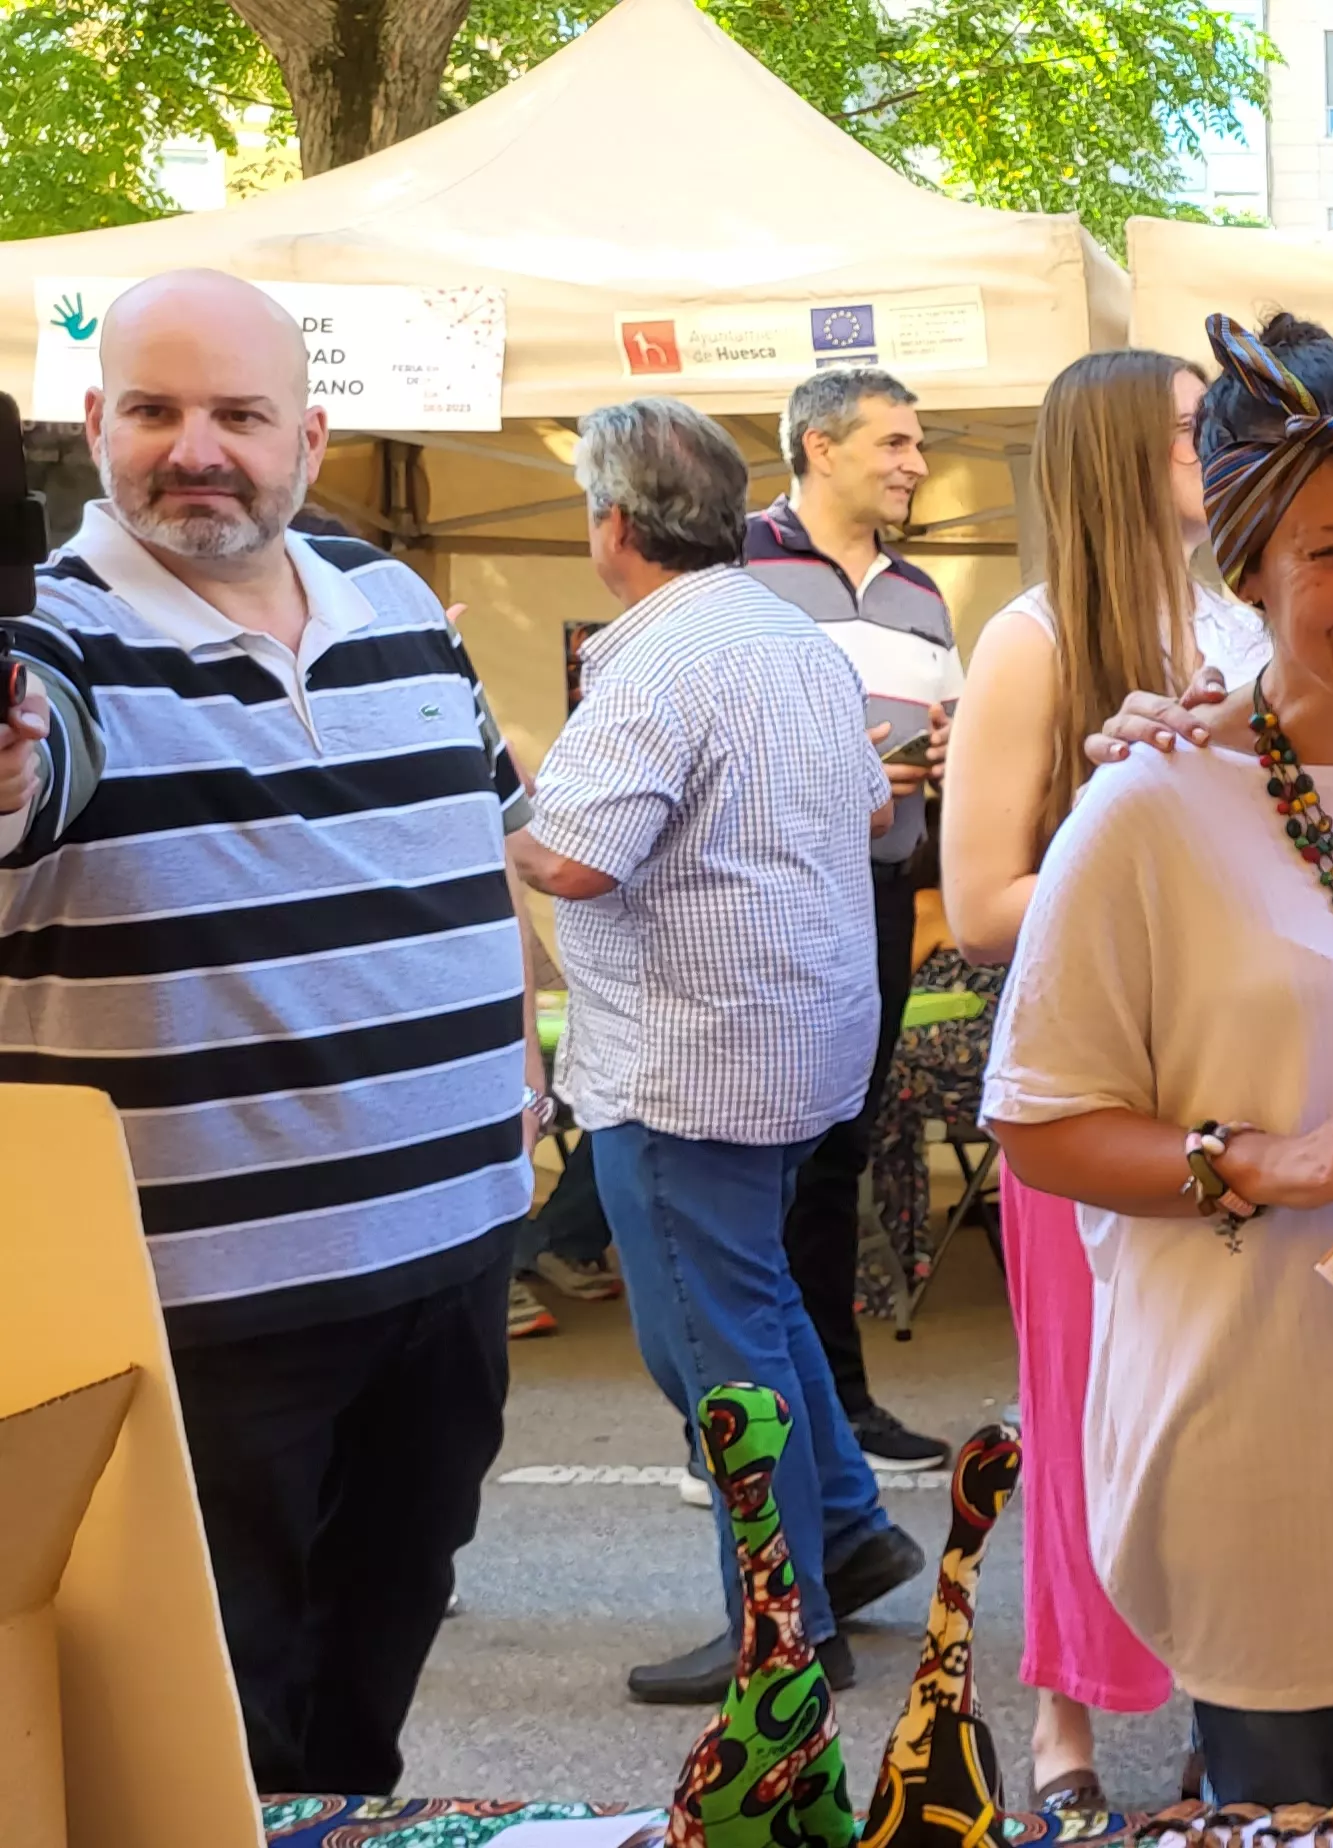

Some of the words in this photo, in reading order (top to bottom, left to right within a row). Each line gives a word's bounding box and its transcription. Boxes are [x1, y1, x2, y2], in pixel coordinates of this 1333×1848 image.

[302, 317, 334, 334] DE
[306, 349, 346, 365] AD
[716, 346, 777, 361] Huesca
